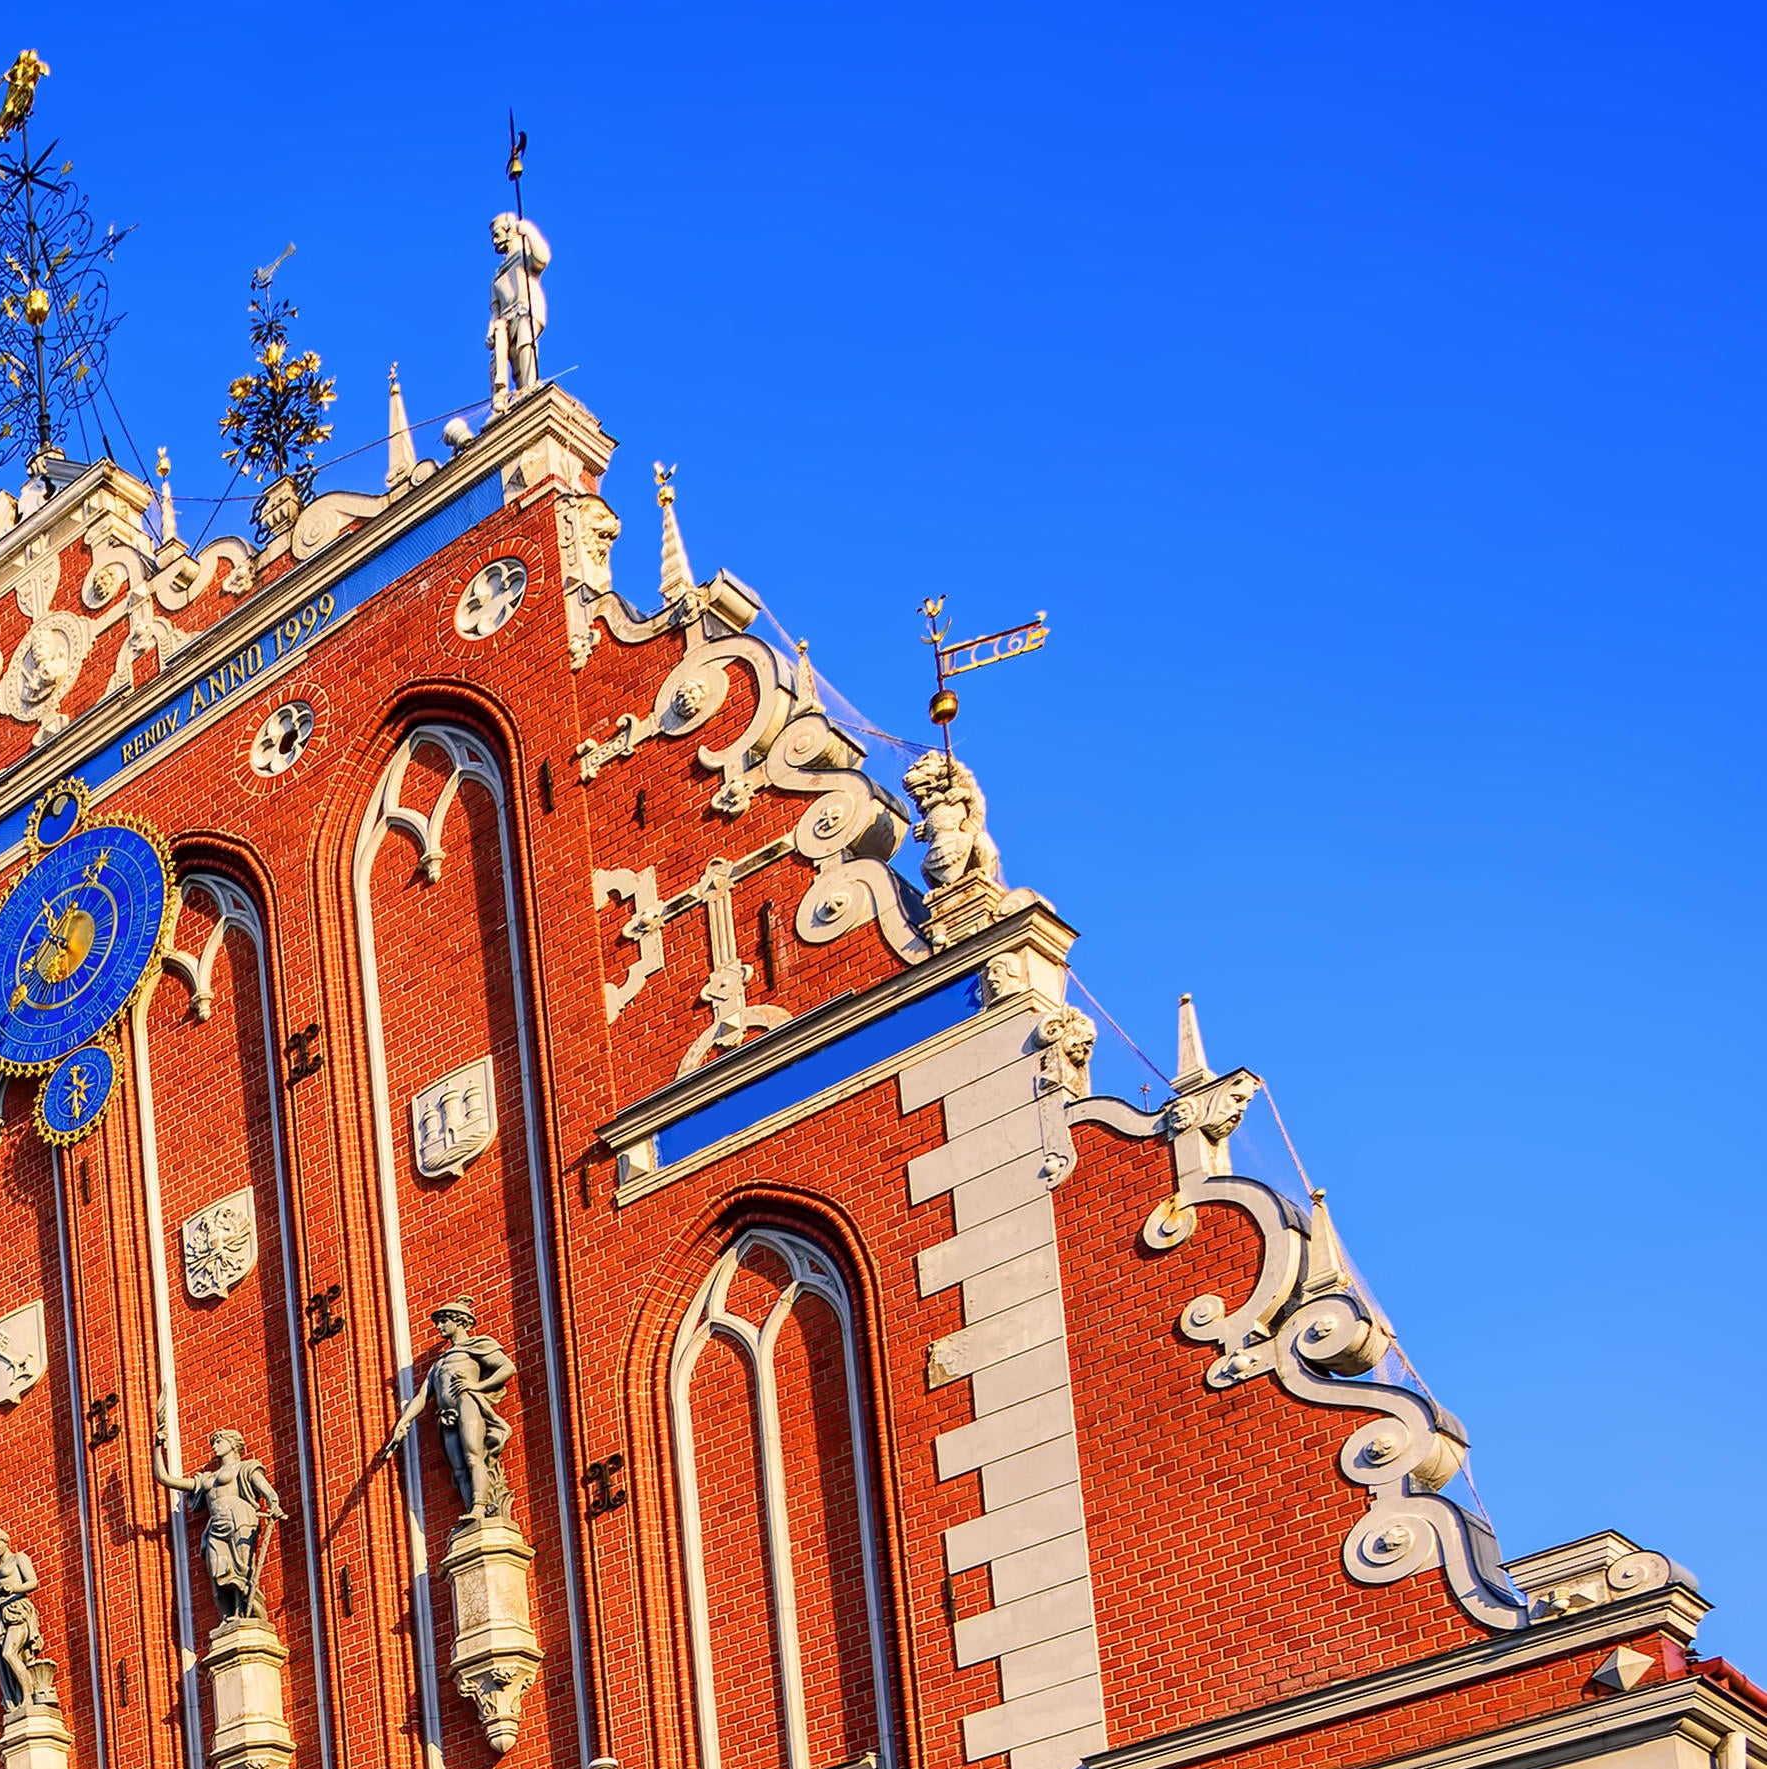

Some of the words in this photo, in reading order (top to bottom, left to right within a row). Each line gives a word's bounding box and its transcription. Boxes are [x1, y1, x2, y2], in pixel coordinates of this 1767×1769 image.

[121, 708, 180, 764] RENOV.
[187, 644, 264, 721] ANNO
[273, 592, 335, 659] 1999
[110, 956, 132, 985] MAY
